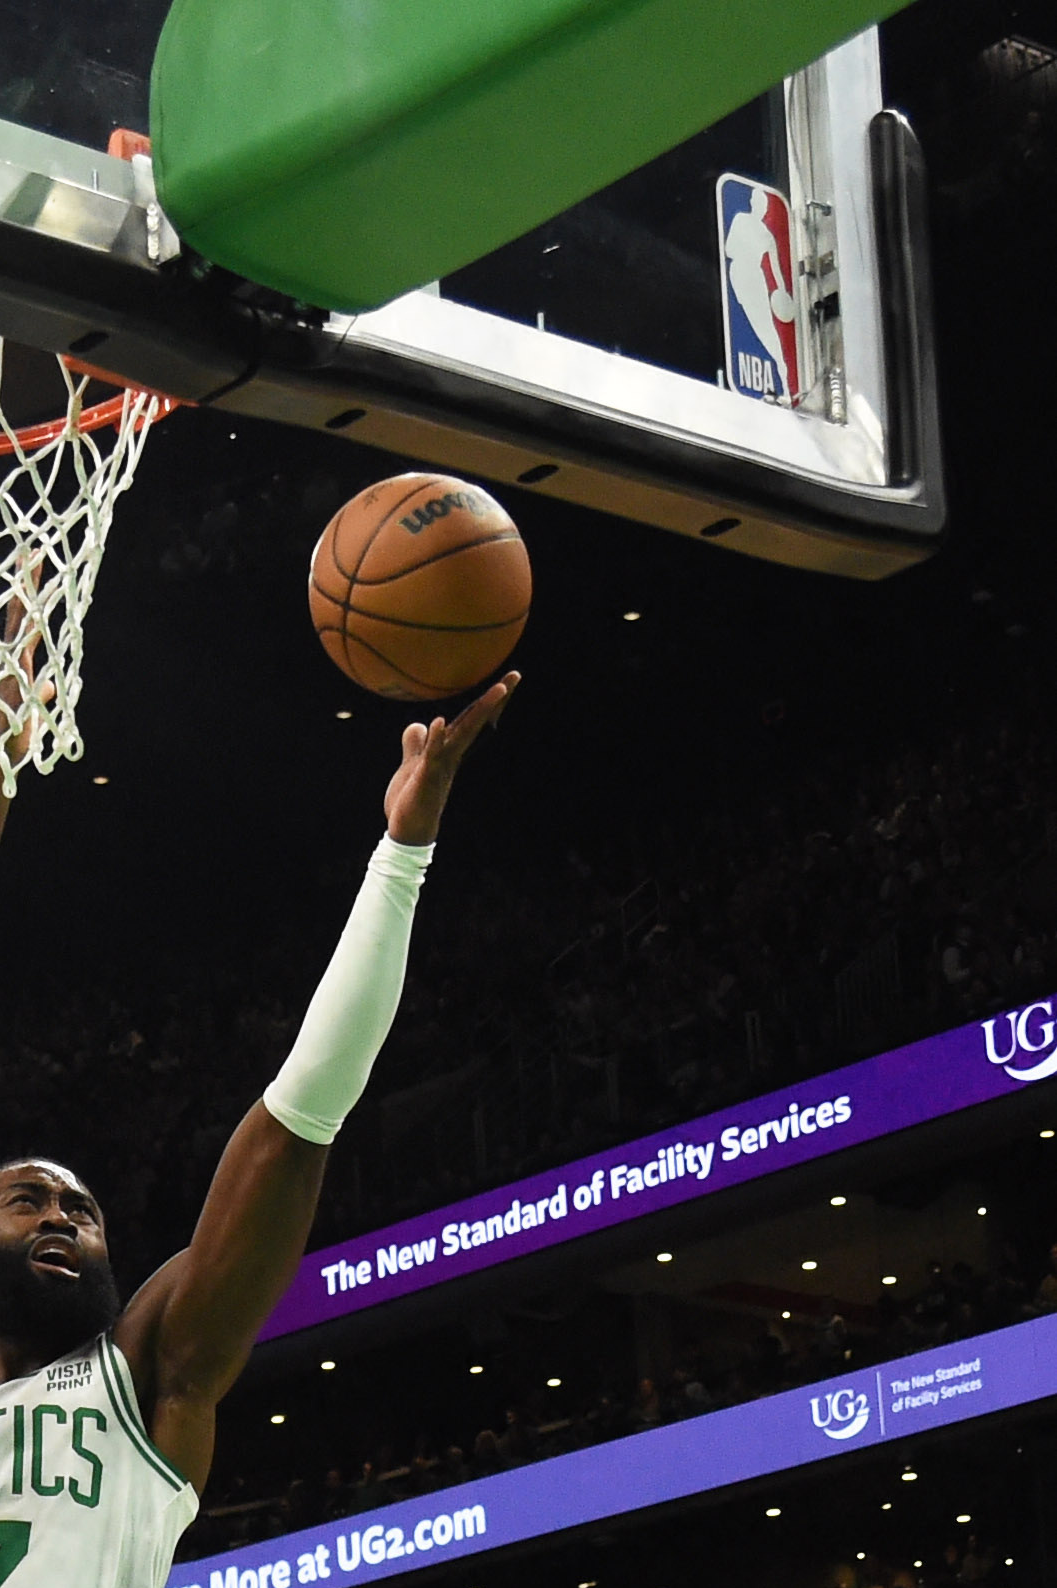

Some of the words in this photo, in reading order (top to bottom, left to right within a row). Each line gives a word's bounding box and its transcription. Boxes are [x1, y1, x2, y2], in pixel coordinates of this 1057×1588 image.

[738, 351, 775, 394] NBA
[981, 1002, 1057, 1064] UG
[321, 1259, 371, 1295] The
[376, 1238, 436, 1278] New
[442, 1184, 568, 1256] Standard
[573, 1170, 604, 1211] of
[610, 1142, 715, 1200] Facility
[720, 1096, 852, 1161] Services
[47, 1361, 92, 1381] VISTA
[47, 1374, 92, 1392] PRINT
[890, 1380, 910, 1394] The
[911, 1374, 934, 1389] New
[935, 1357, 981, 1382] Standard
[810, 1389, 870, 1428] UG2
[892, 1397, 903, 1413] of
[904, 1391, 940, 1409] Facility
[941, 1379, 982, 1399] Services
[297, 1544, 331, 1584] at
[337, 1504, 486, 1572] UG2.com
